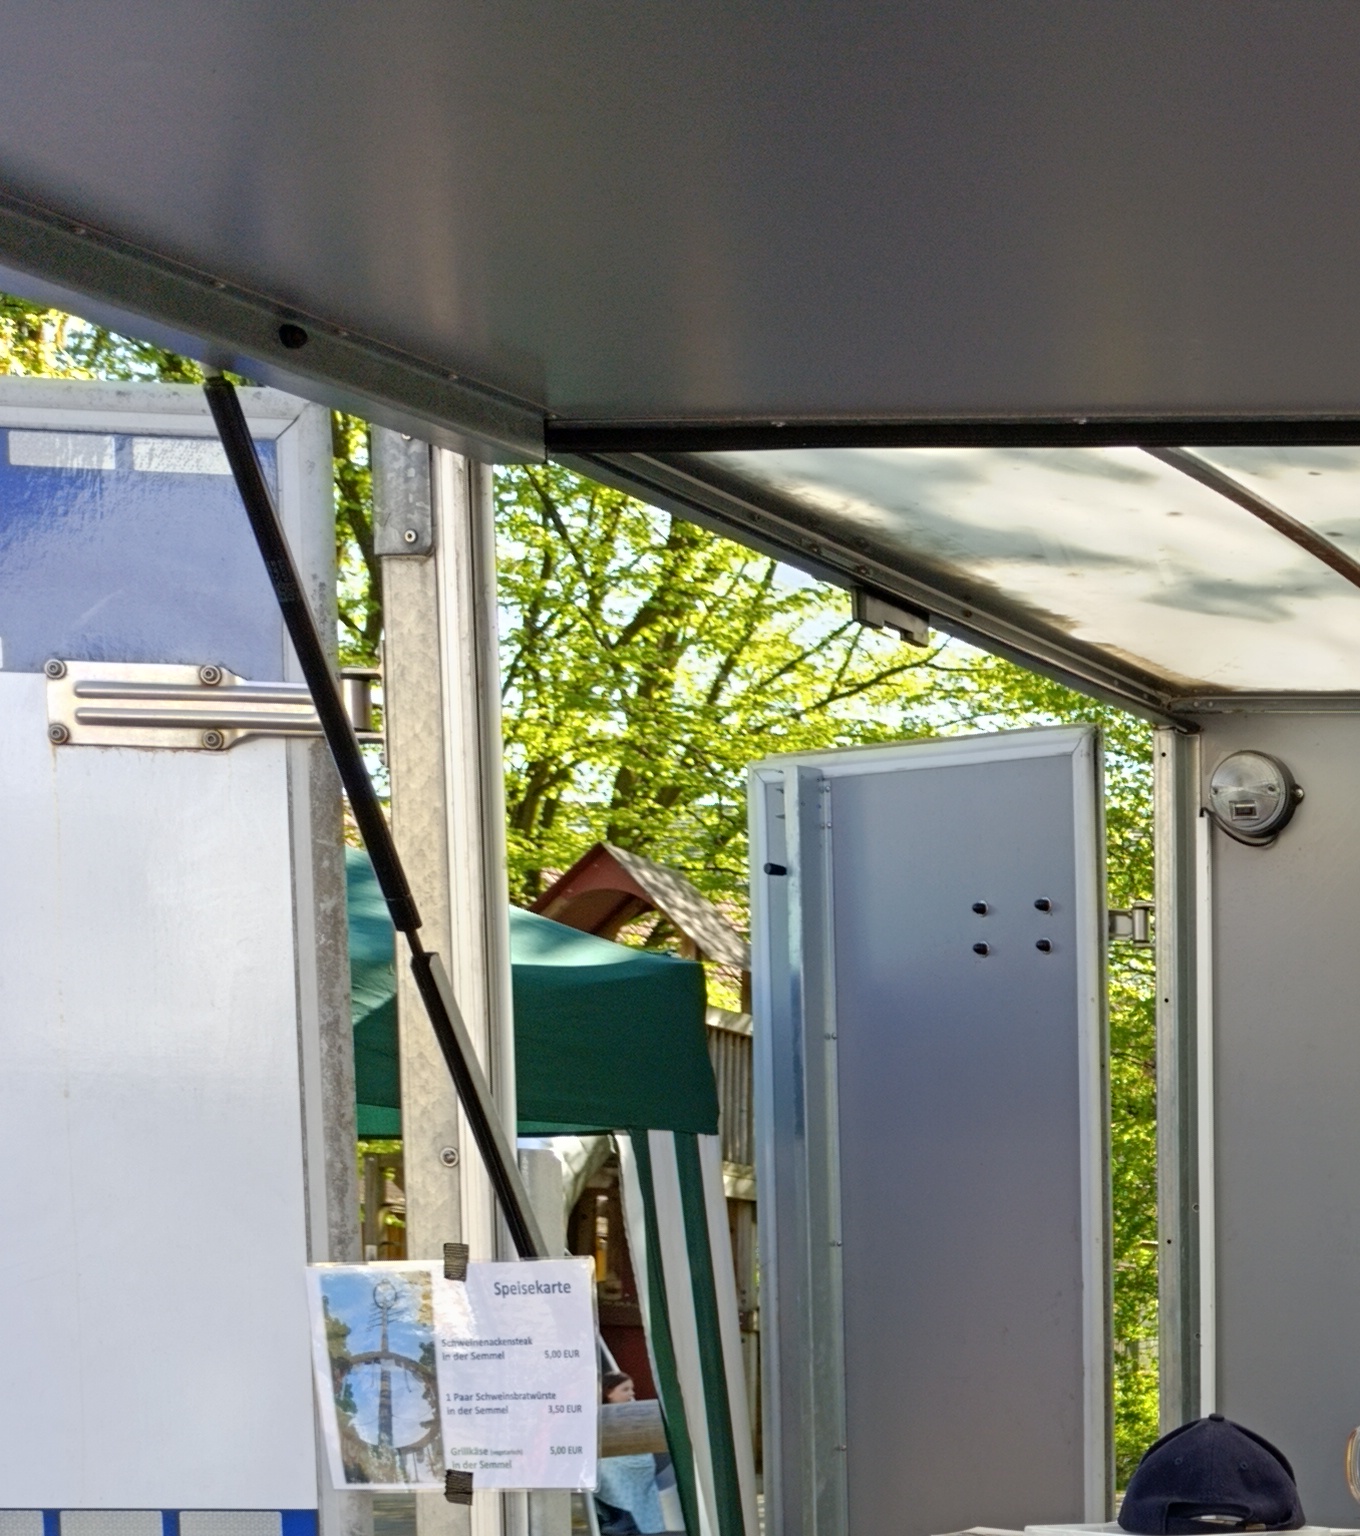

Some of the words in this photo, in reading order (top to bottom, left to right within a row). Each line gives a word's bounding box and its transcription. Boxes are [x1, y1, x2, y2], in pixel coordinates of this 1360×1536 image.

[494, 1280, 571, 1297] Speisekarte
[441, 1337, 533, 1347] Schweinenackensteak
[442, 1351, 450, 1361] in
[453, 1351, 468, 1361] der
[470, 1351, 505, 1360] Semmel
[544, 1350, 561, 1359] 5,00
[563, 1350, 579, 1358] EUR
[453, 1393, 473, 1401] Paar
[475, 1391, 556, 1401] Schweinsbratwürste
[447, 1407, 455, 1415] in
[458, 1406, 473, 1415] der
[475, 1406, 509, 1414] Semmel
[548, 1405, 563, 1414] 3,50
[565, 1405, 582, 1413] EUR
[451, 1446, 488, 1456] Grillkäse
[549, 1447, 565, 1456] 5,00
[567, 1446, 583, 1455] EUR
[452, 1461, 460, 1469] in
[463, 1461, 477, 1469] der
[479, 1460, 512, 1469] Semmel
